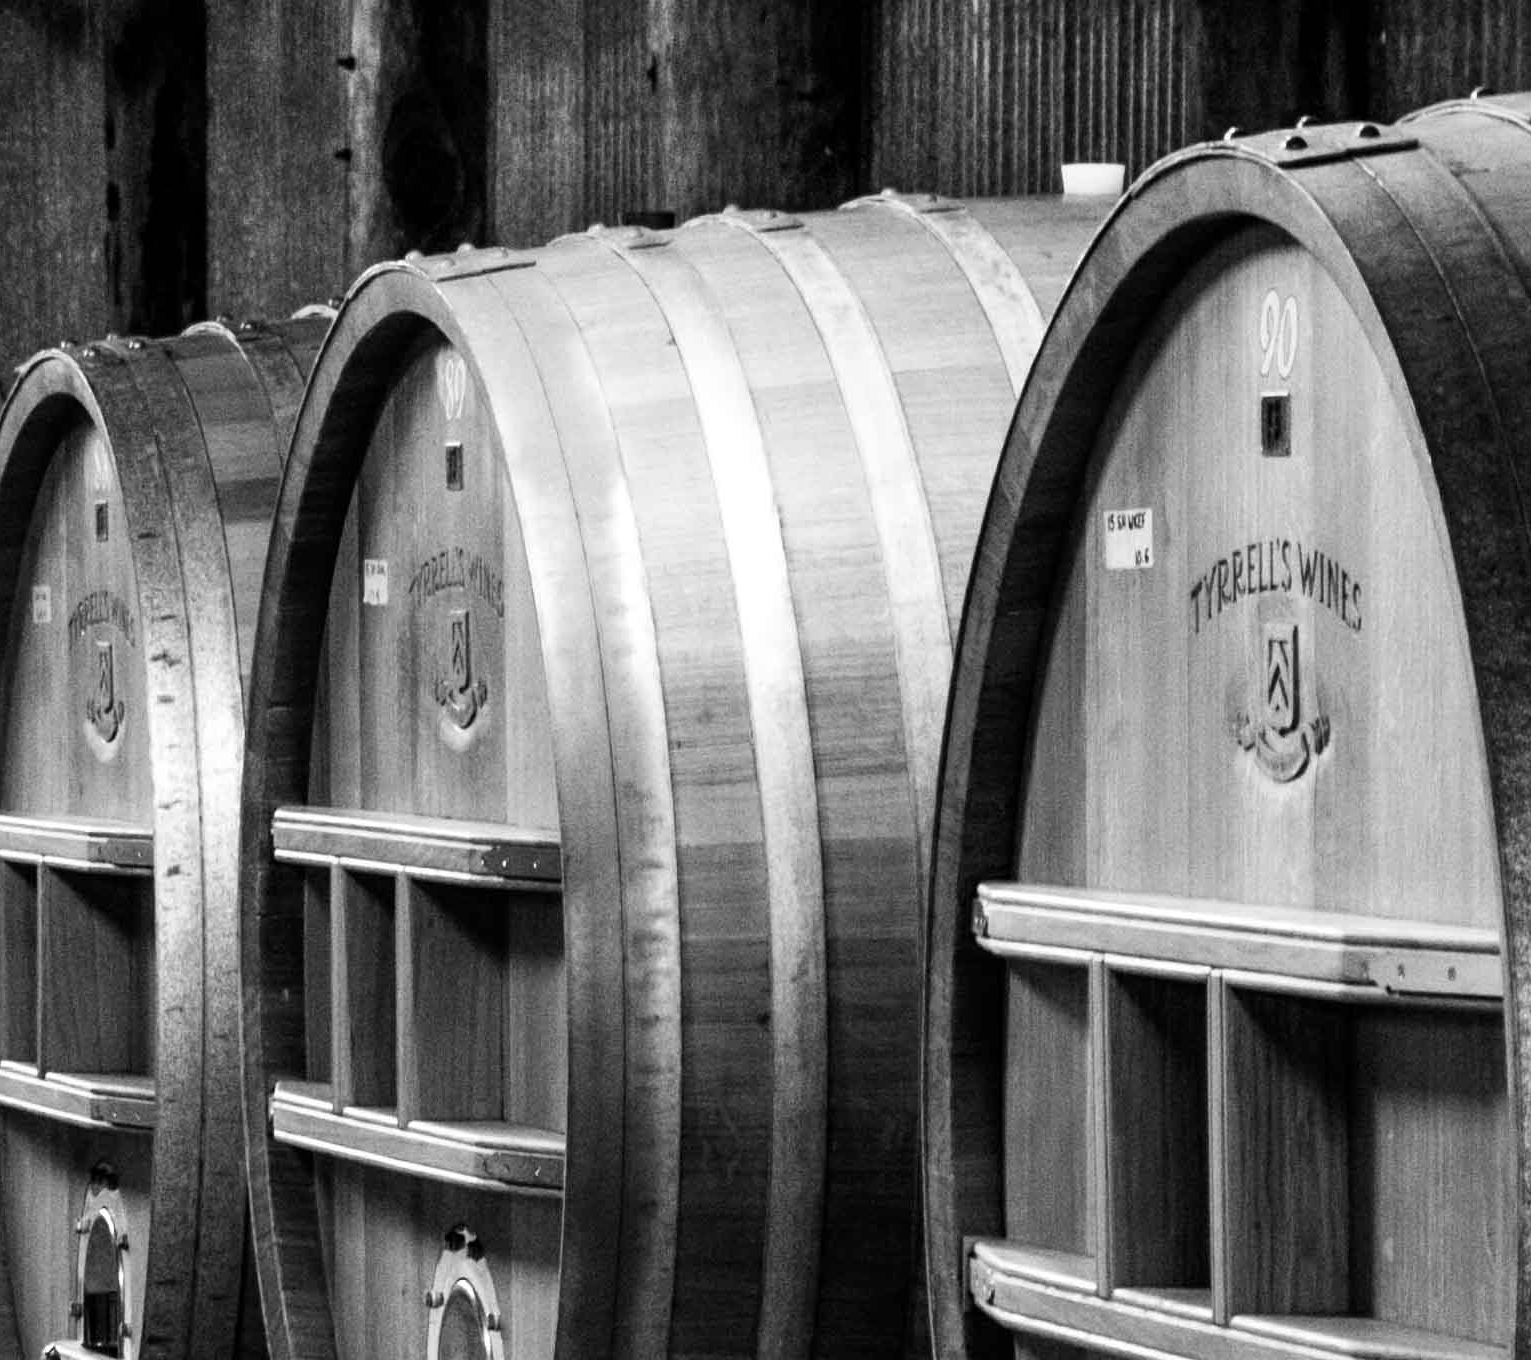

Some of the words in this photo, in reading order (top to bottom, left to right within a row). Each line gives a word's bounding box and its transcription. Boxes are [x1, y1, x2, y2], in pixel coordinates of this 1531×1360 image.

[1260, 289, 1298, 379] 90
[1190, 538, 1293, 635] TYRRELL'S
[1297, 541, 1363, 632] WINES
